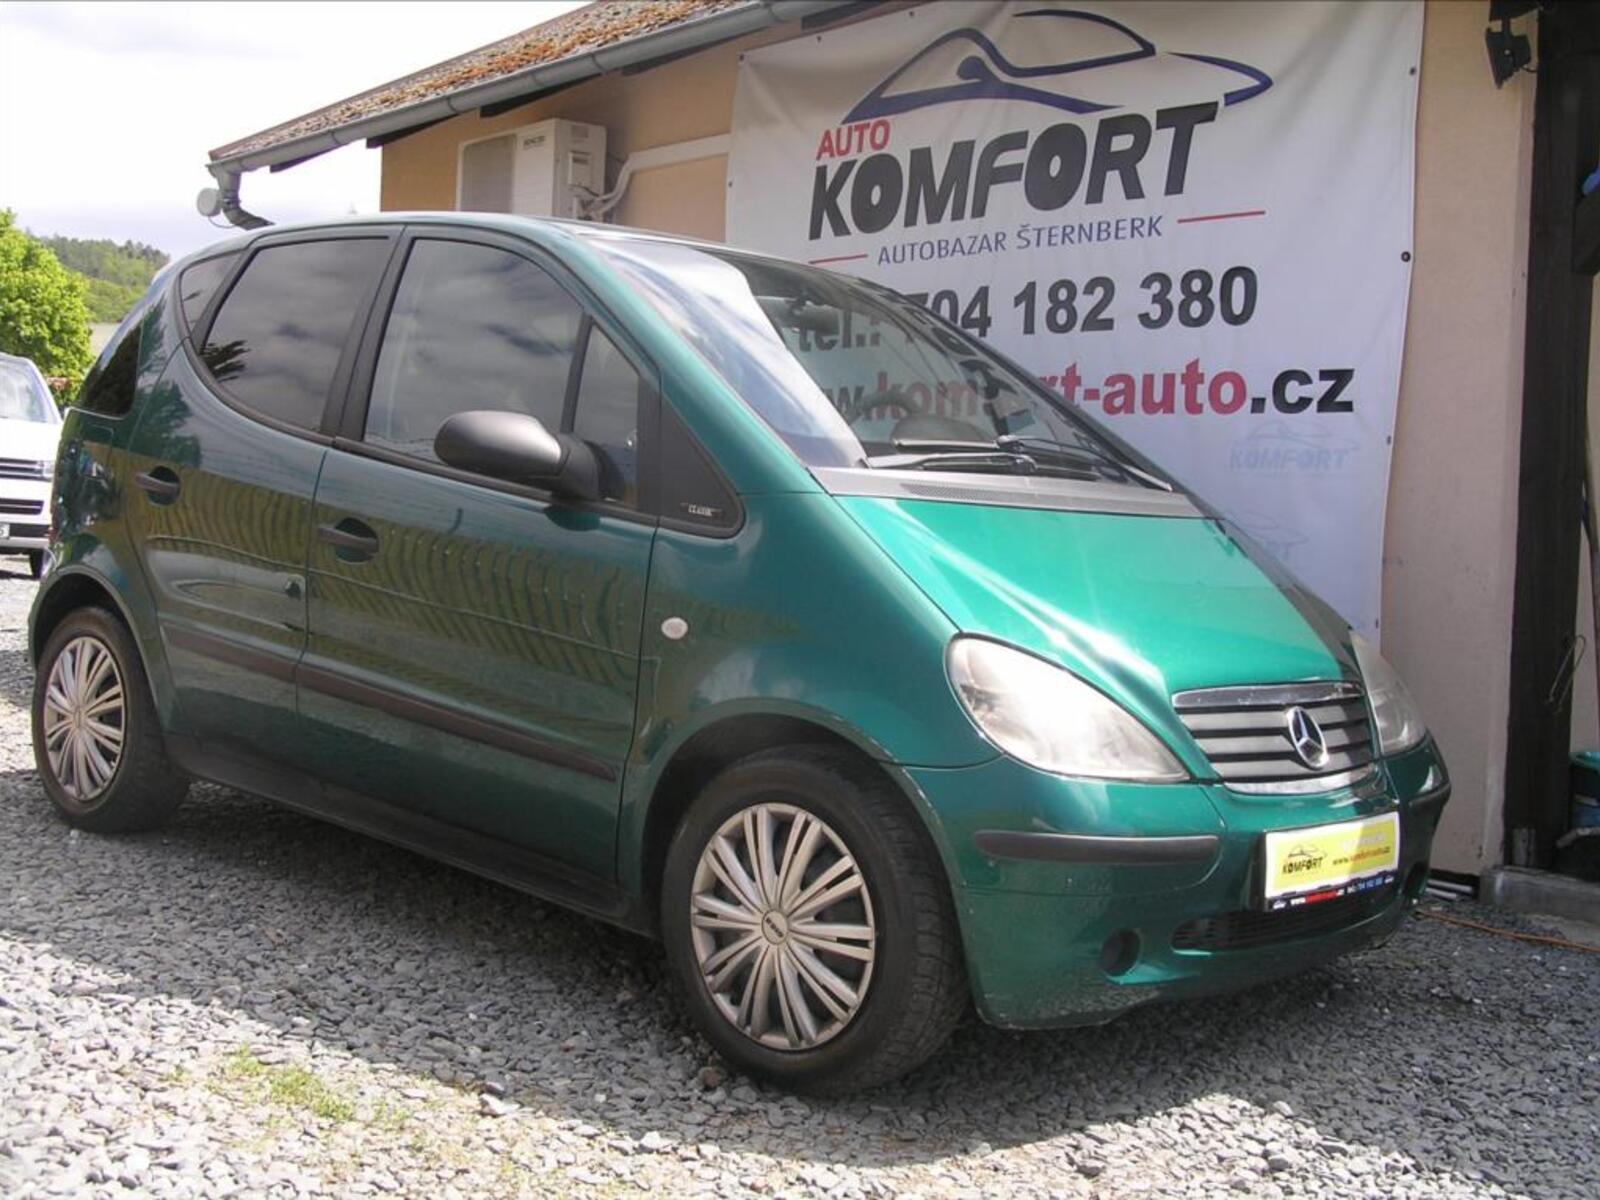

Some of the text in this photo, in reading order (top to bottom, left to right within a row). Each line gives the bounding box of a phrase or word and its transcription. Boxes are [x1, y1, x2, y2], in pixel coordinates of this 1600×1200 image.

[816, 119, 891, 161] AUTO
[808, 100, 1219, 241] KOMFORT
[877, 214, 1164, 267] AUTOBAZAR ŠTERNBERK
[1012, 276, 1116, 336] 182
[1137, 265, 1259, 330] 380
[1230, 446, 1352, 472] KOMFORT
[1282, 857, 1323, 874] KOMFORT
